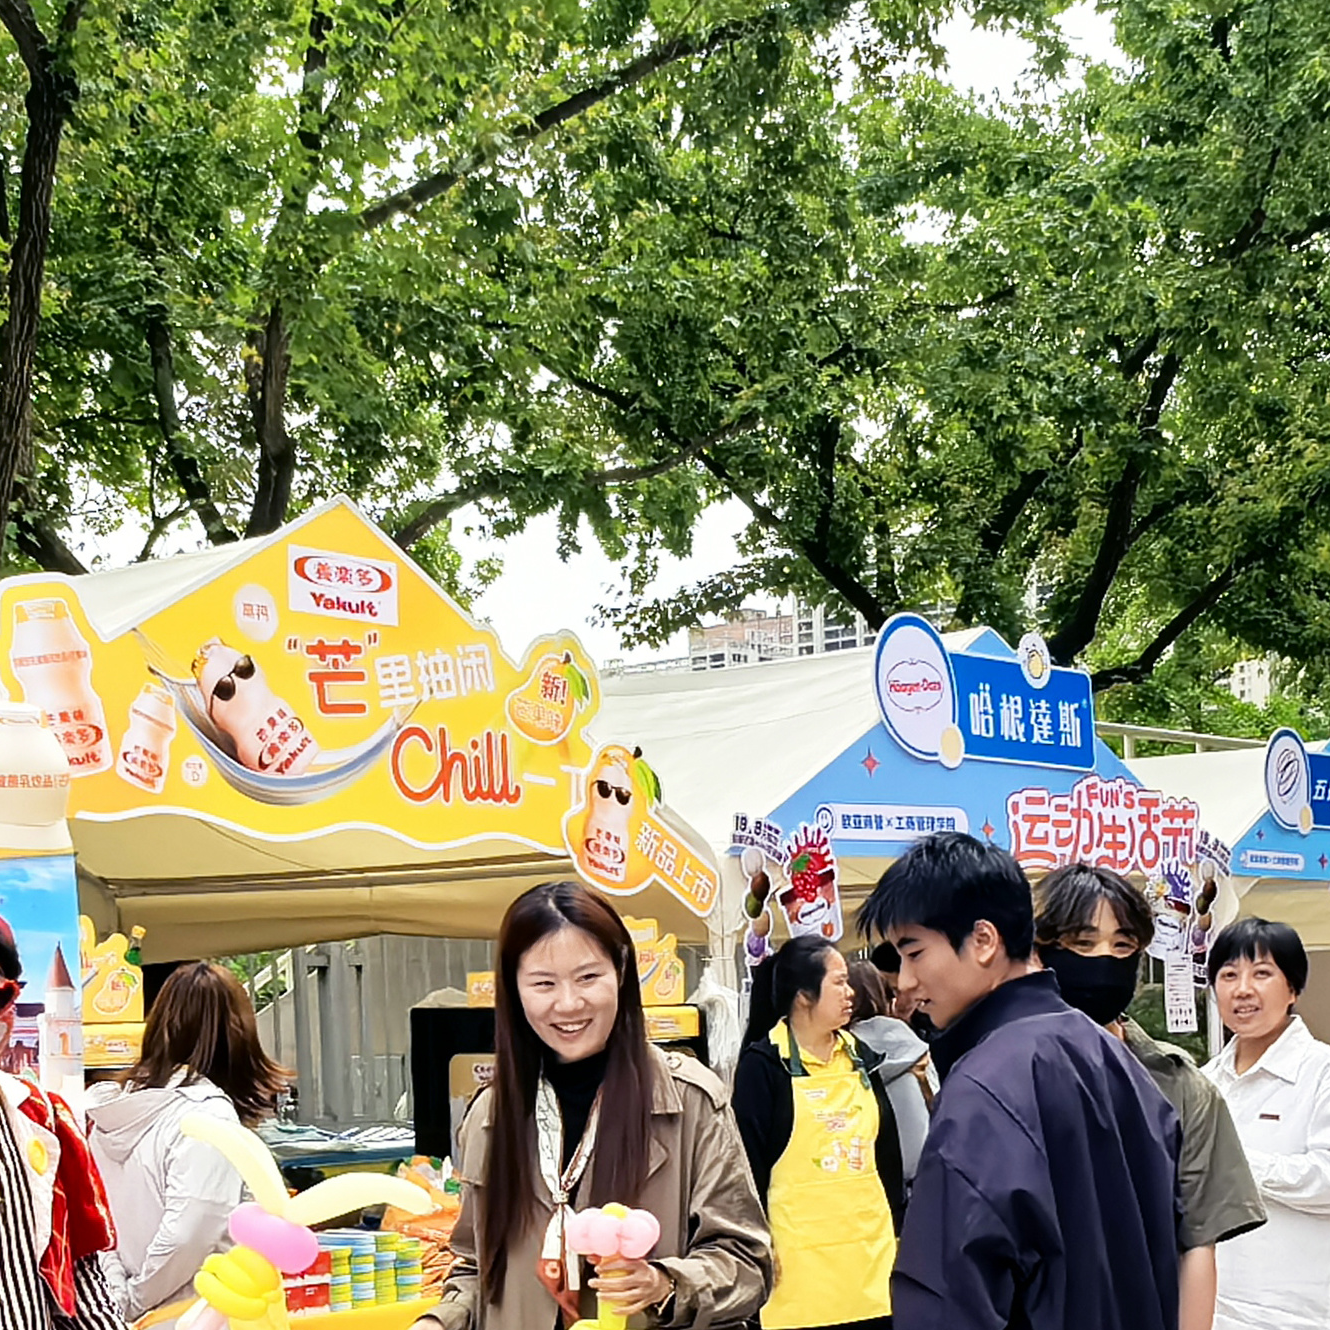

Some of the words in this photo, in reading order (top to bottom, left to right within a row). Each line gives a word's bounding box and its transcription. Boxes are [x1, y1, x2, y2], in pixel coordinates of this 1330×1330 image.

[310, 591, 378, 618] Yakult
[968, 682, 1082, 748] 哈根達斯
[391, 726, 521, 804] Chill
[634, 821, 714, 905] 新品上市
[1010, 788, 1196, 869] 运动生活节
